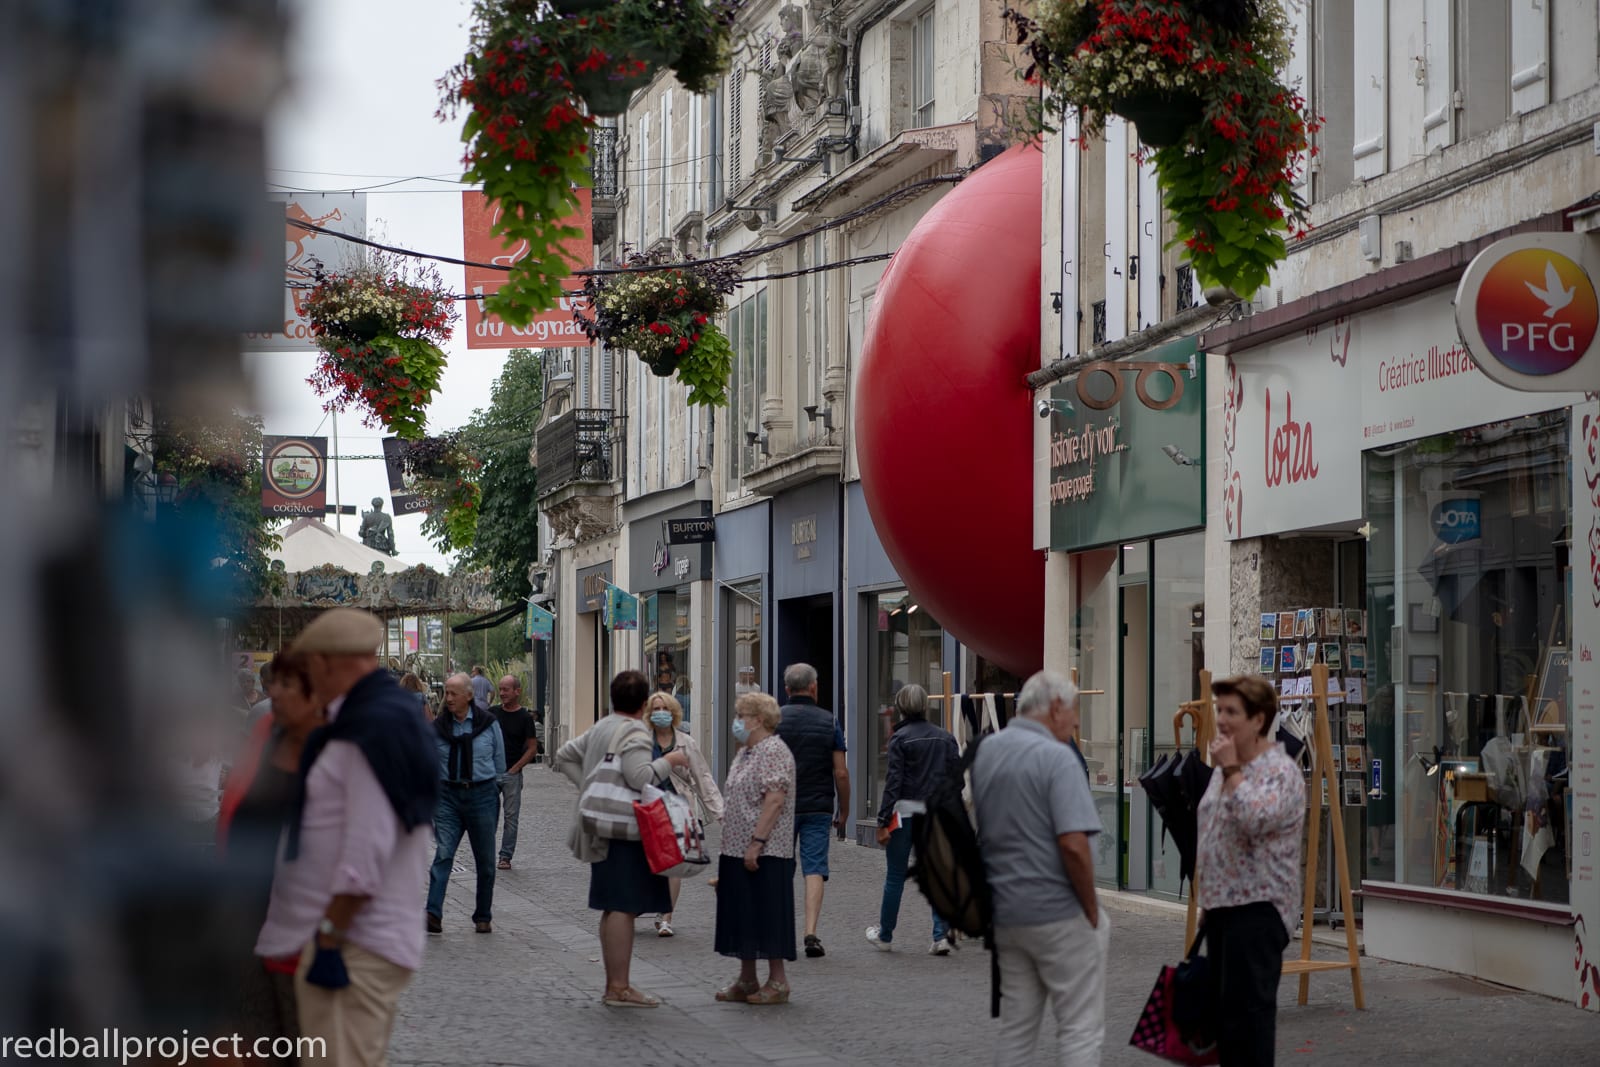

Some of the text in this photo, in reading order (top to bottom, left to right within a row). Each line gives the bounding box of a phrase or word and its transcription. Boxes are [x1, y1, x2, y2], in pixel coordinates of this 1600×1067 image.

[475, 318, 504, 337] du
[1501, 322, 1575, 352] PFG
[1379, 353, 1425, 392] Créatrice
[273, 504, 314, 513] COGNAC
[672, 521, 714, 533] BURTON
